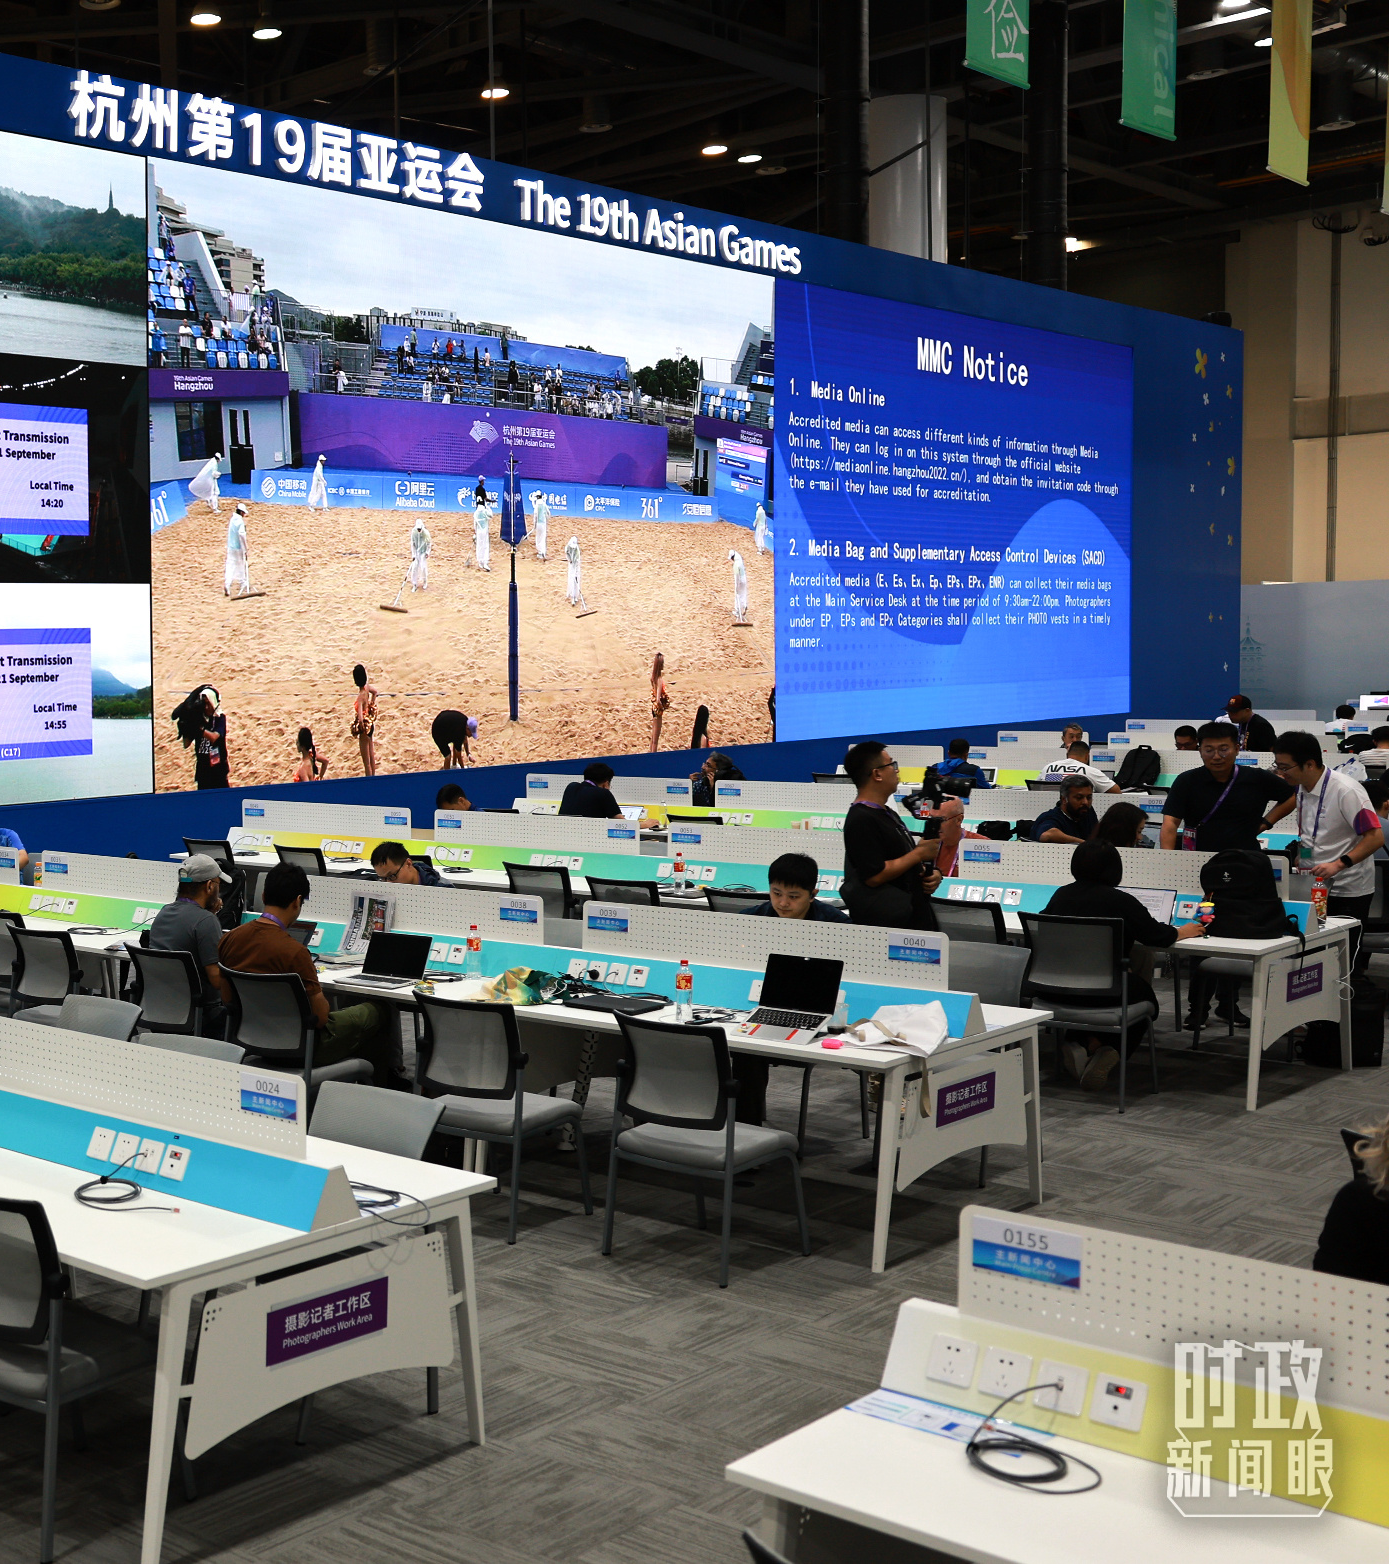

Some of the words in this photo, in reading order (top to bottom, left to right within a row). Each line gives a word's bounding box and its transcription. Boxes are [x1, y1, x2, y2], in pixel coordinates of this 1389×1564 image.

[66, 69, 485, 212] 杭州第19届亚运会
[513, 178, 571, 228] The
[576, 193, 639, 242] 19th
[642, 208, 716, 258] Asian
[719, 224, 802, 275] Games
[917, 336, 952, 375] MMC
[963, 344, 1028, 387] Notice
[174, 381, 214, 392] Hangzhou
[811, 380, 842, 401] Media
[848, 385, 885, 407] Online
[3, 430, 70, 445] Transmission
[788, 411, 840, 430] Accredited
[844, 417, 870, 434] media
[874, 424, 888, 436] can
[893, 427, 920, 439] access
[924, 426, 964, 444] different
[967, 432, 989, 447] kinds
[1005, 436, 1048, 453] information
[1051, 442, 1077, 458] through
[1080, 445, 1098, 459] Media
[5, 447, 57, 461] September
[788, 432, 822, 449] Online.
[830, 436, 850, 454] They
[854, 442, 869, 453] can
[875, 441, 888, 458] log
[920, 445, 938, 460] this
[942, 449, 968, 465] system
[972, 451, 1001, 469] through
[1004, 454, 1017, 468] the
[1020, 455, 1050, 471] official
[1054, 459, 1081, 474] website
[29, 480, 51, 491] Local
[52, 481, 75, 492] Time
[788, 473, 804, 489] the
[809, 475, 839, 491] e-mail
[844, 478, 865, 495] they
[868, 480, 888, 495] have
[892, 482, 911, 496] used
[915, 483, 928, 498] for
[933, 485, 990, 502] accreditation.
[975, 470, 989, 483] and
[992, 471, 1017, 486] obtain
[1020, 474, 1033, 487] the
[1037, 475, 1073, 491] invitation
[1076, 479, 1091, 492] code
[1094, 481, 1118, 496] through
[40, 498, 64, 509] 14:20
[395, 497, 418, 508] Alibaba
[418, 498, 435, 508] Cloud
[808, 539, 839, 557] Media
[845, 540, 864, 560] Bag
[869, 541, 888, 558] and
[893, 542, 965, 563] Supplementary
[969, 545, 1000, 562] Access
[1005, 546, 1038, 563] Control
[1043, 548, 1076, 564] Devices
[1081, 548, 1105, 566] (SACD)
[789, 571, 840, 586] Accredited
[844, 573, 870, 587] media
[1009, 580, 1021, 588] can
[1024, 576, 1051, 589] collect
[1055, 577, 1073, 589] their
[1076, 578, 1094, 589] media
[1097, 578, 1111, 591] bags
[805, 592, 820, 606] the
[825, 592, 845, 606] Main
[850, 592, 884, 606] Service
[888, 593, 907, 606] Desk
[924, 593, 938, 606] the
[942, 594, 959, 606] time
[963, 594, 989, 609] period
[1065, 594, 1110, 608] Photographers
[789, 613, 815, 627] under
[840, 613, 855, 626] EPs
[860, 613, 875, 626] and
[879, 612, 893, 626] EPx
[897, 612, 943, 628] Categories
[946, 612, 967, 625] shall
[971, 612, 1000, 625] collect
[1004, 612, 1024, 624] their
[1027, 612, 1047, 624] PHOTO
[1050, 614, 1069, 624] vests
[1089, 612, 1110, 625] timely
[789, 637, 823, 648] manner.
[6, 654, 73, 667] Transmission
[8, 672, 60, 686] September
[33, 703, 55, 713] Local
[56, 702, 78, 713] Time
[44, 720, 67, 731] 14:55
[0, 747, 21, 759] (C17)
[1046, 764, 1087, 775] NASA
[510, 900, 527, 909] 0038
[599, 908, 618, 917] 0039
[346, 928, 359, 950] CHINA
[903, 937, 926, 947] 0040
[255, 1080, 280, 1095] 0024
[1003, 1228, 1049, 1250] 0155
[284, 1291, 372, 1334] 摄影记者工作区
[282, 1324, 337, 1349] Photographers
[337, 1317, 356, 1332] Work
[356, 1313, 373, 1325] Area
